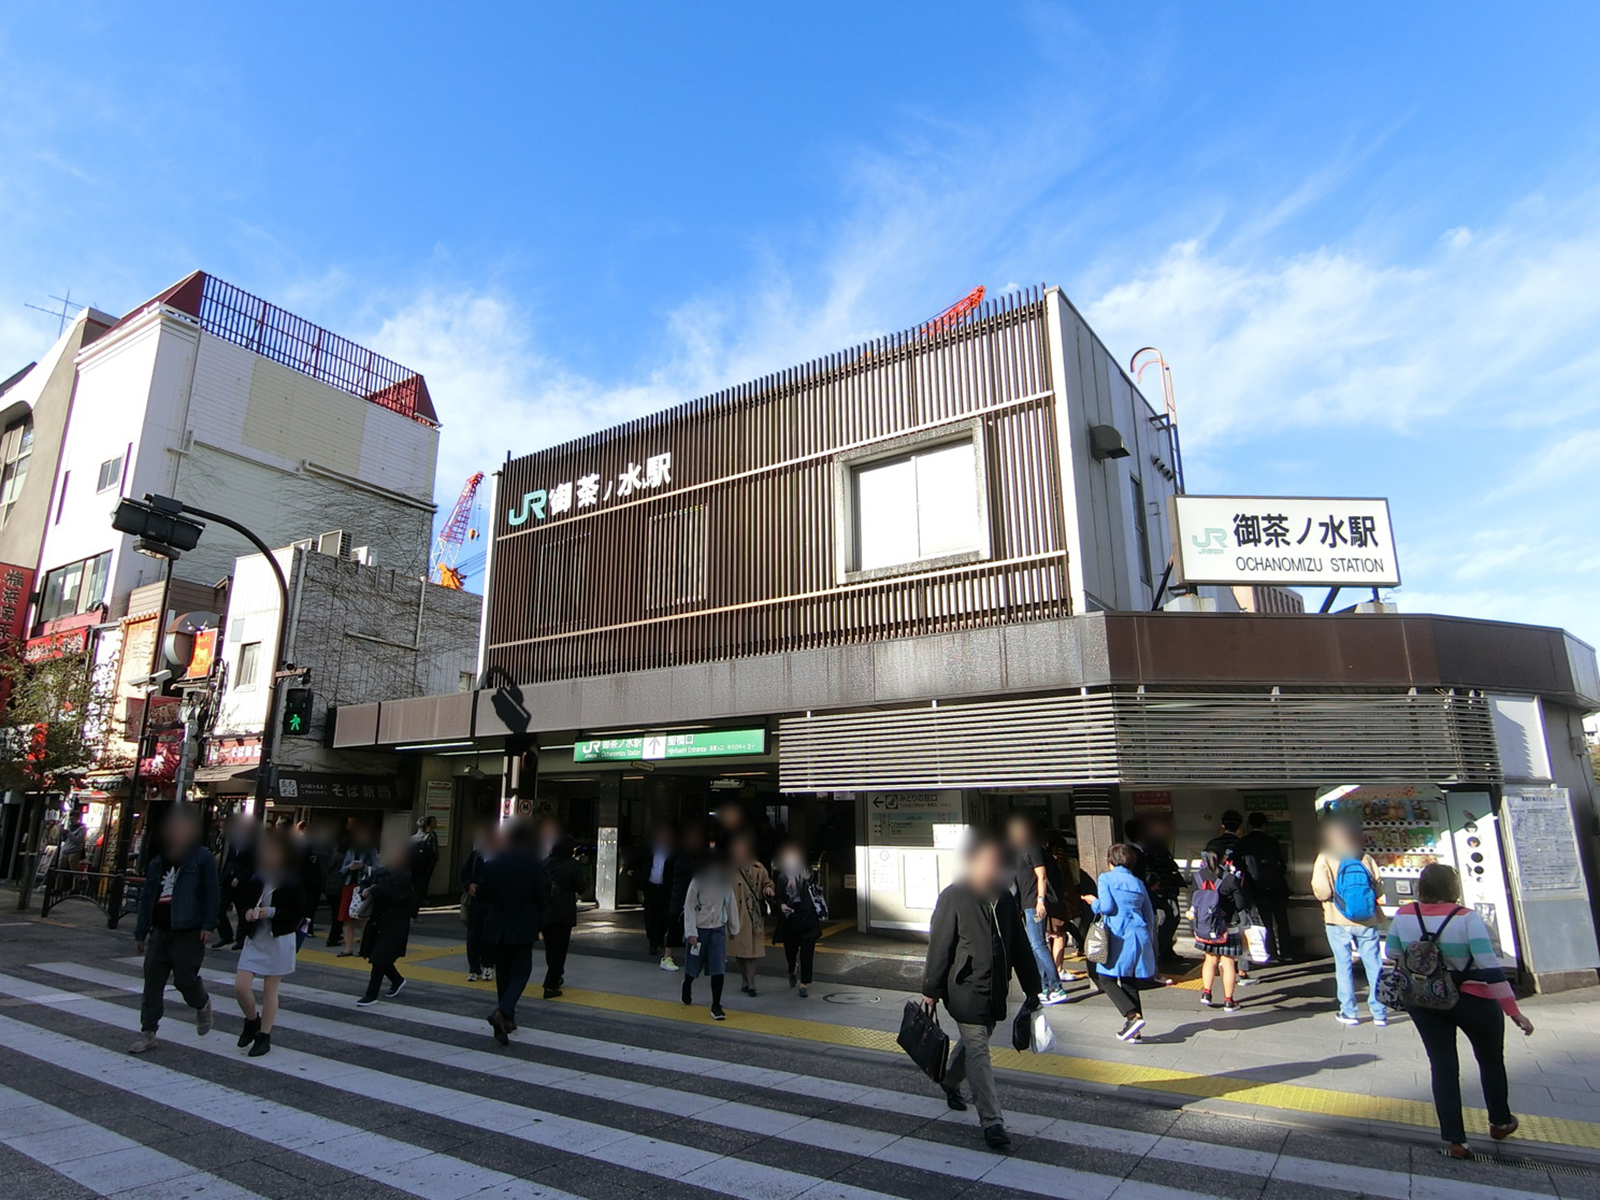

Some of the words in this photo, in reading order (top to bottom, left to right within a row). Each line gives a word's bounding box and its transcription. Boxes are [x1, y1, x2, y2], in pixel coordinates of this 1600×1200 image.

[508, 489, 547, 526] JR
[549, 452, 671, 516] 御茶ノ水駅
[1192, 528, 1228, 548] JR
[1233, 513, 1379, 548] 御茶ノ水駅
[1236, 556, 1323, 572] OCHANOMIZU
[1331, 558, 1385, 573] STATION
[582, 741, 600, 753] JR
